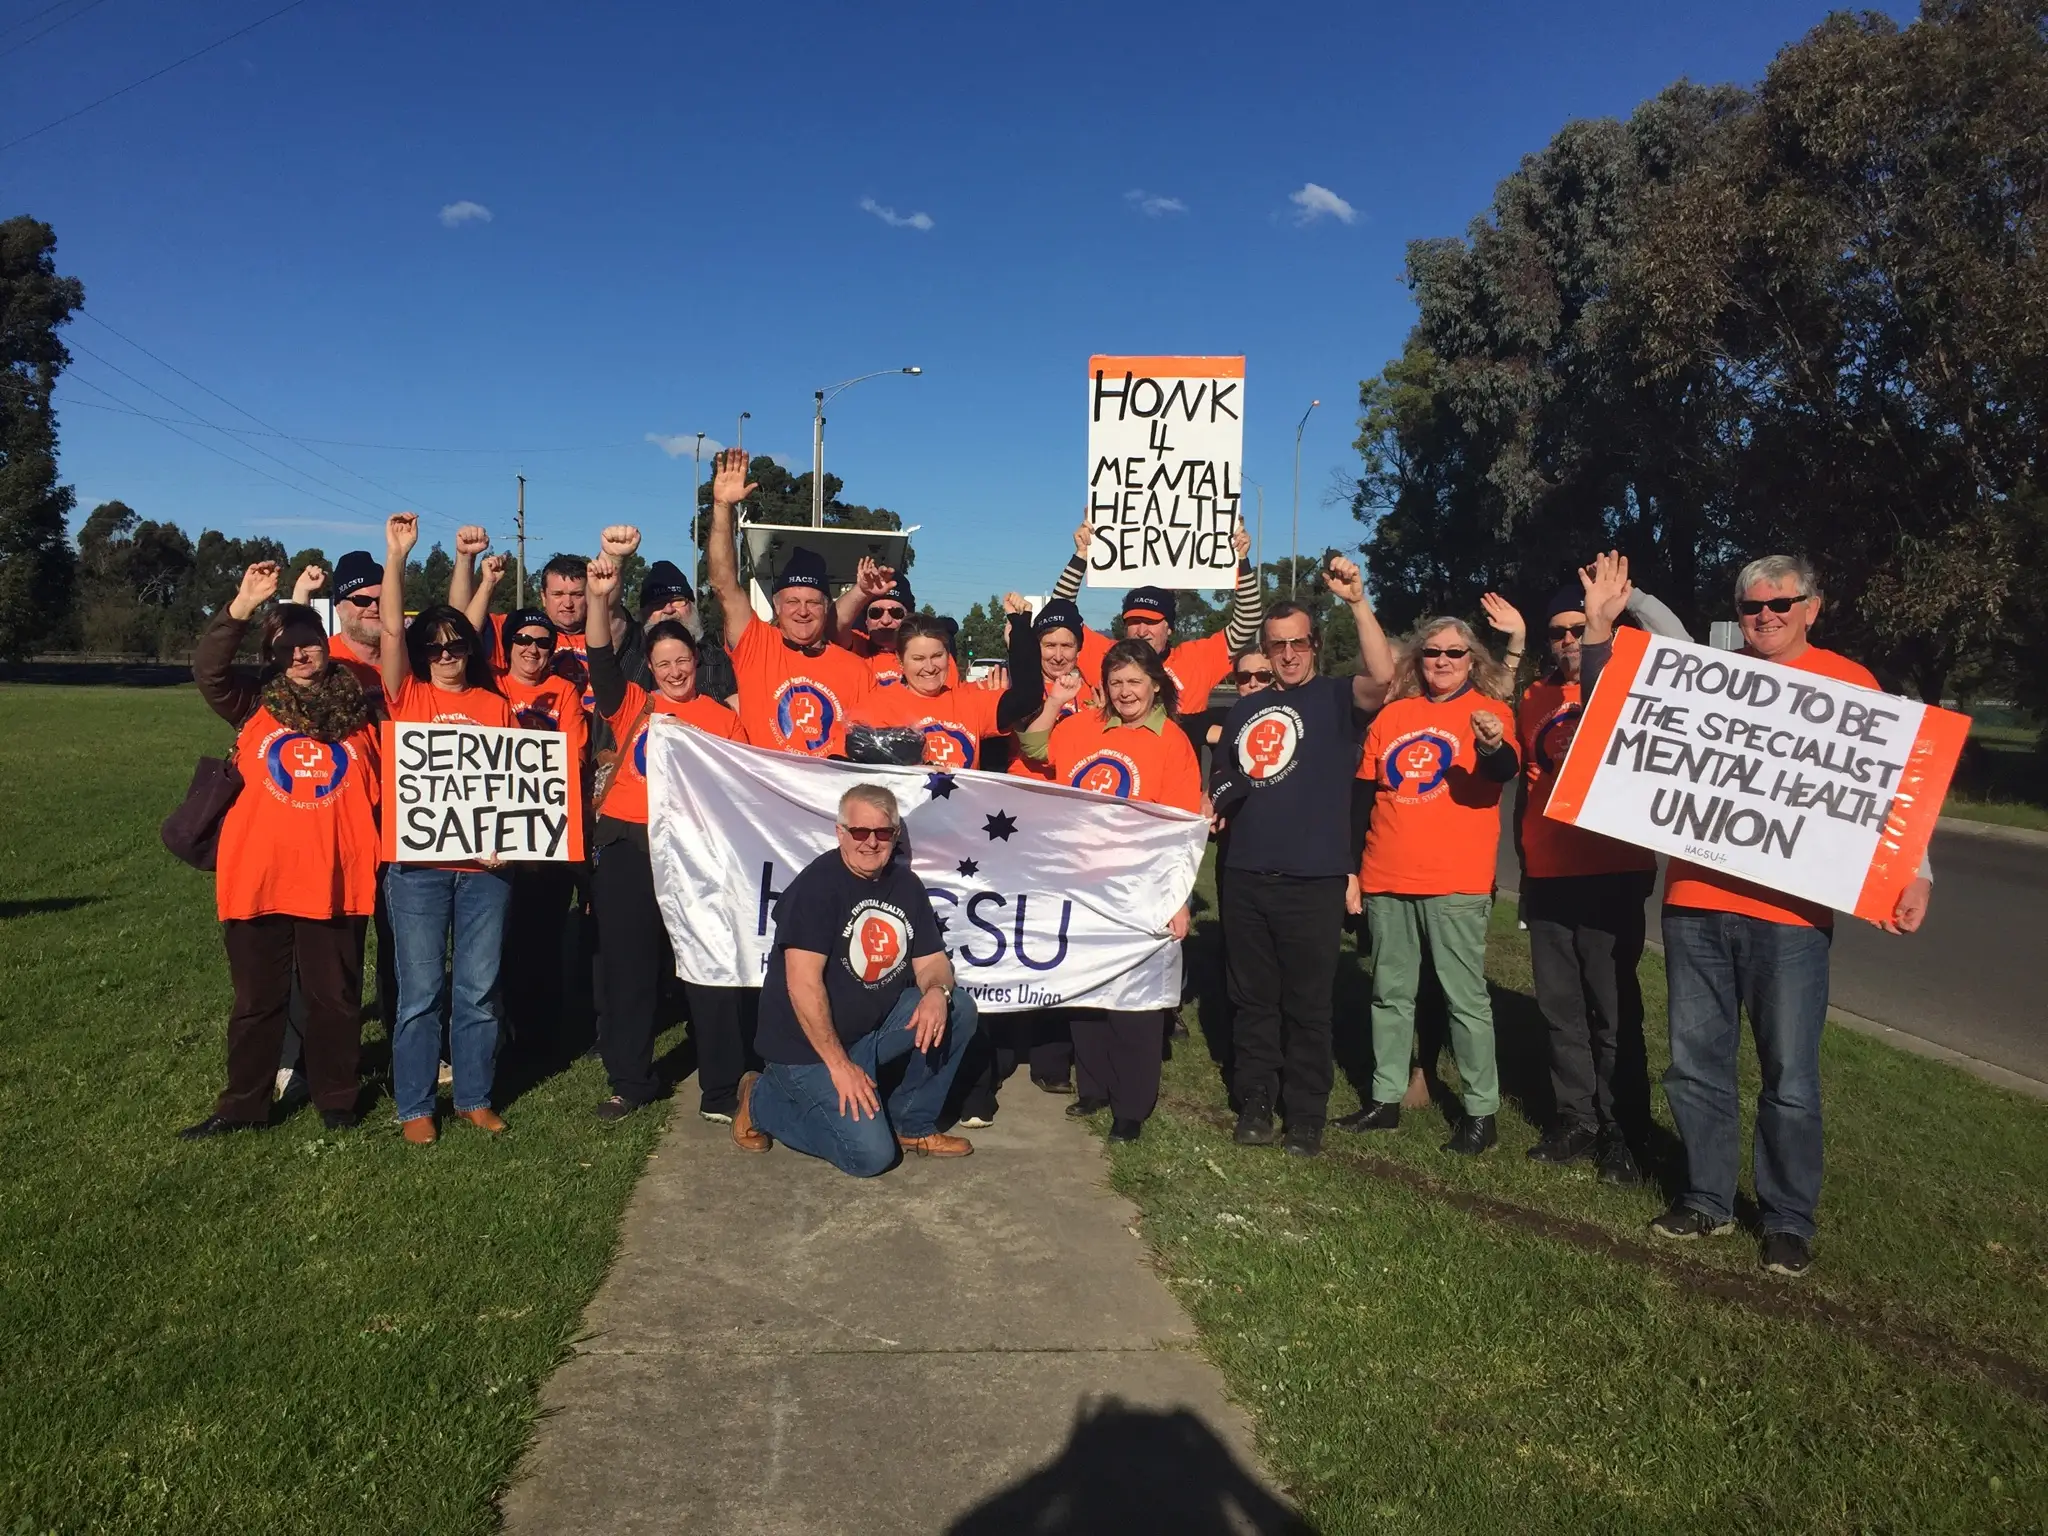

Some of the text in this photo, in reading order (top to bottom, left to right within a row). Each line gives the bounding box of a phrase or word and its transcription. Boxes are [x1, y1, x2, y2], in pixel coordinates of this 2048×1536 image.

[1094, 370, 1239, 423] HONK
[1149, 419, 1175, 461] 4
[1091, 455, 1241, 500] MENTAL
[1091, 490, 1238, 534] HEALTH
[1091, 525, 1237, 571] SERVICES
[788, 576, 819, 585] HACSU
[1133, 597, 1159, 607] HACSU
[1645, 648, 1899, 746] PROUD TO BE
[399, 729, 560, 773] SERVICE
[1627, 692, 1904, 789] THE SPECIALIST
[263, 778, 289, 804] SERVICE
[291, 800, 320, 810] SAFETY
[295, 769, 328, 778] EBA 2016
[399, 773, 567, 807] STAFFING
[1606, 728, 1895, 833] MENTAL HEALTH
[401, 806, 569, 858] SAFETY
[1650, 788, 1805, 859] UNION
